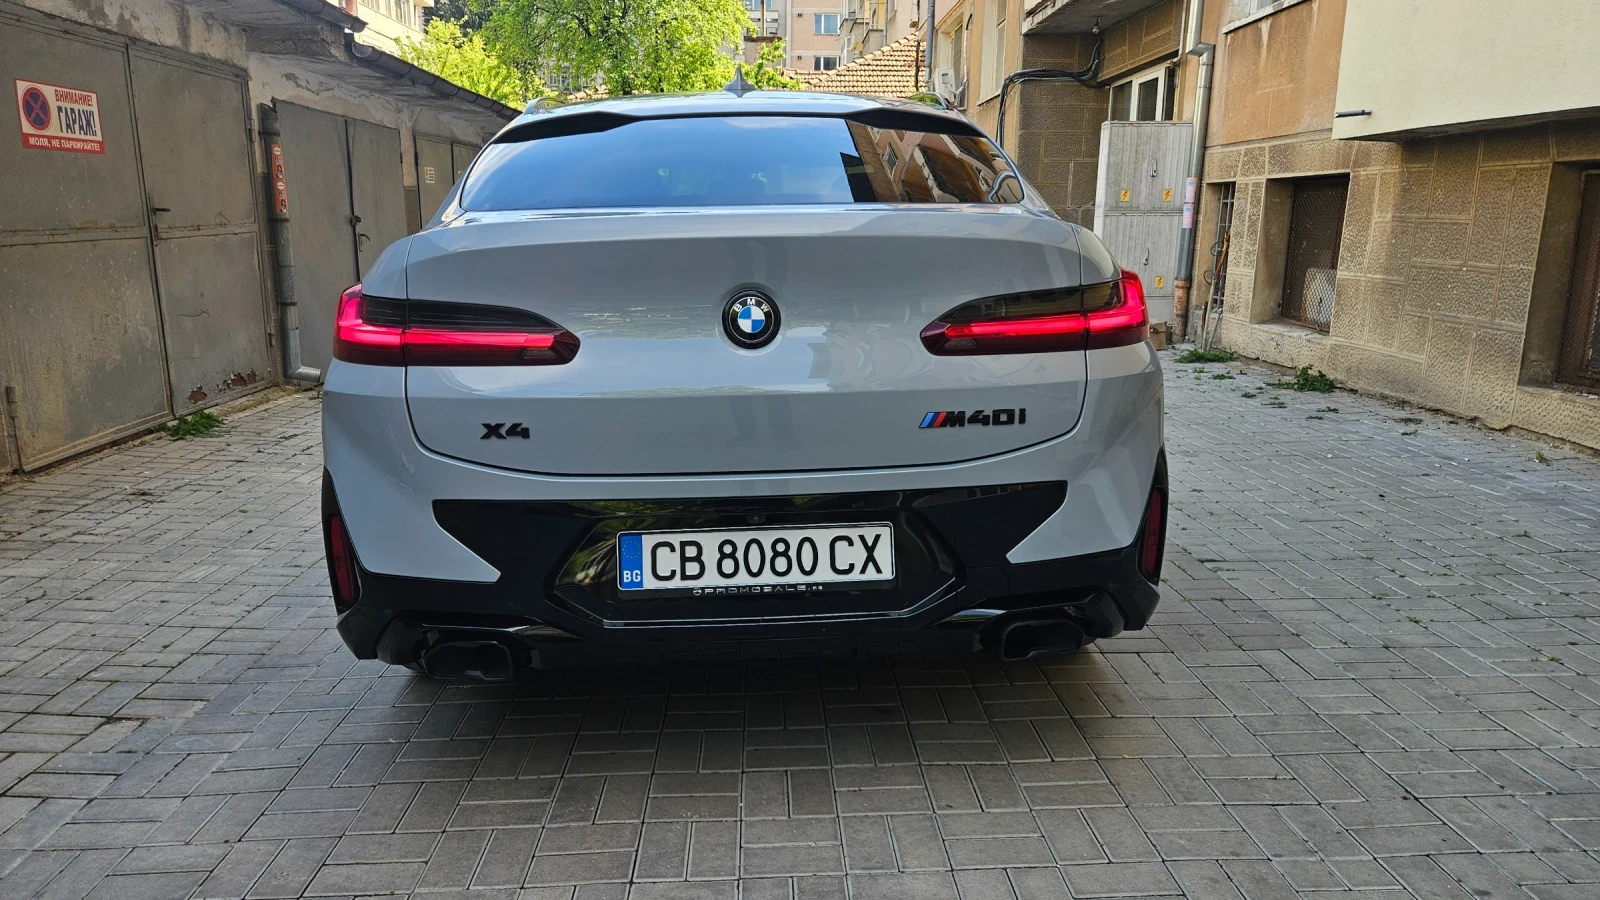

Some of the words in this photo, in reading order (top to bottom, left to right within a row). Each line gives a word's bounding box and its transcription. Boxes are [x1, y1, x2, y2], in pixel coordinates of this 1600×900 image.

[54, 89, 93, 107] ВНИМАНИЕ!
[56, 105, 97, 137] ГАРАЖ!
[29, 136, 51, 149] МОЛЯ,
[50, 138, 61, 148] НЕ
[61, 140, 101, 151] ПАРКИРАЙТЕ!
[733, 298, 770, 313] BMW
[480, 422, 530, 440] X4
[650, 540, 706, 581] CB
[716, 536, 819, 579] 8080
[829, 533, 883, 576] CX
[623, 570, 641, 583] BG
